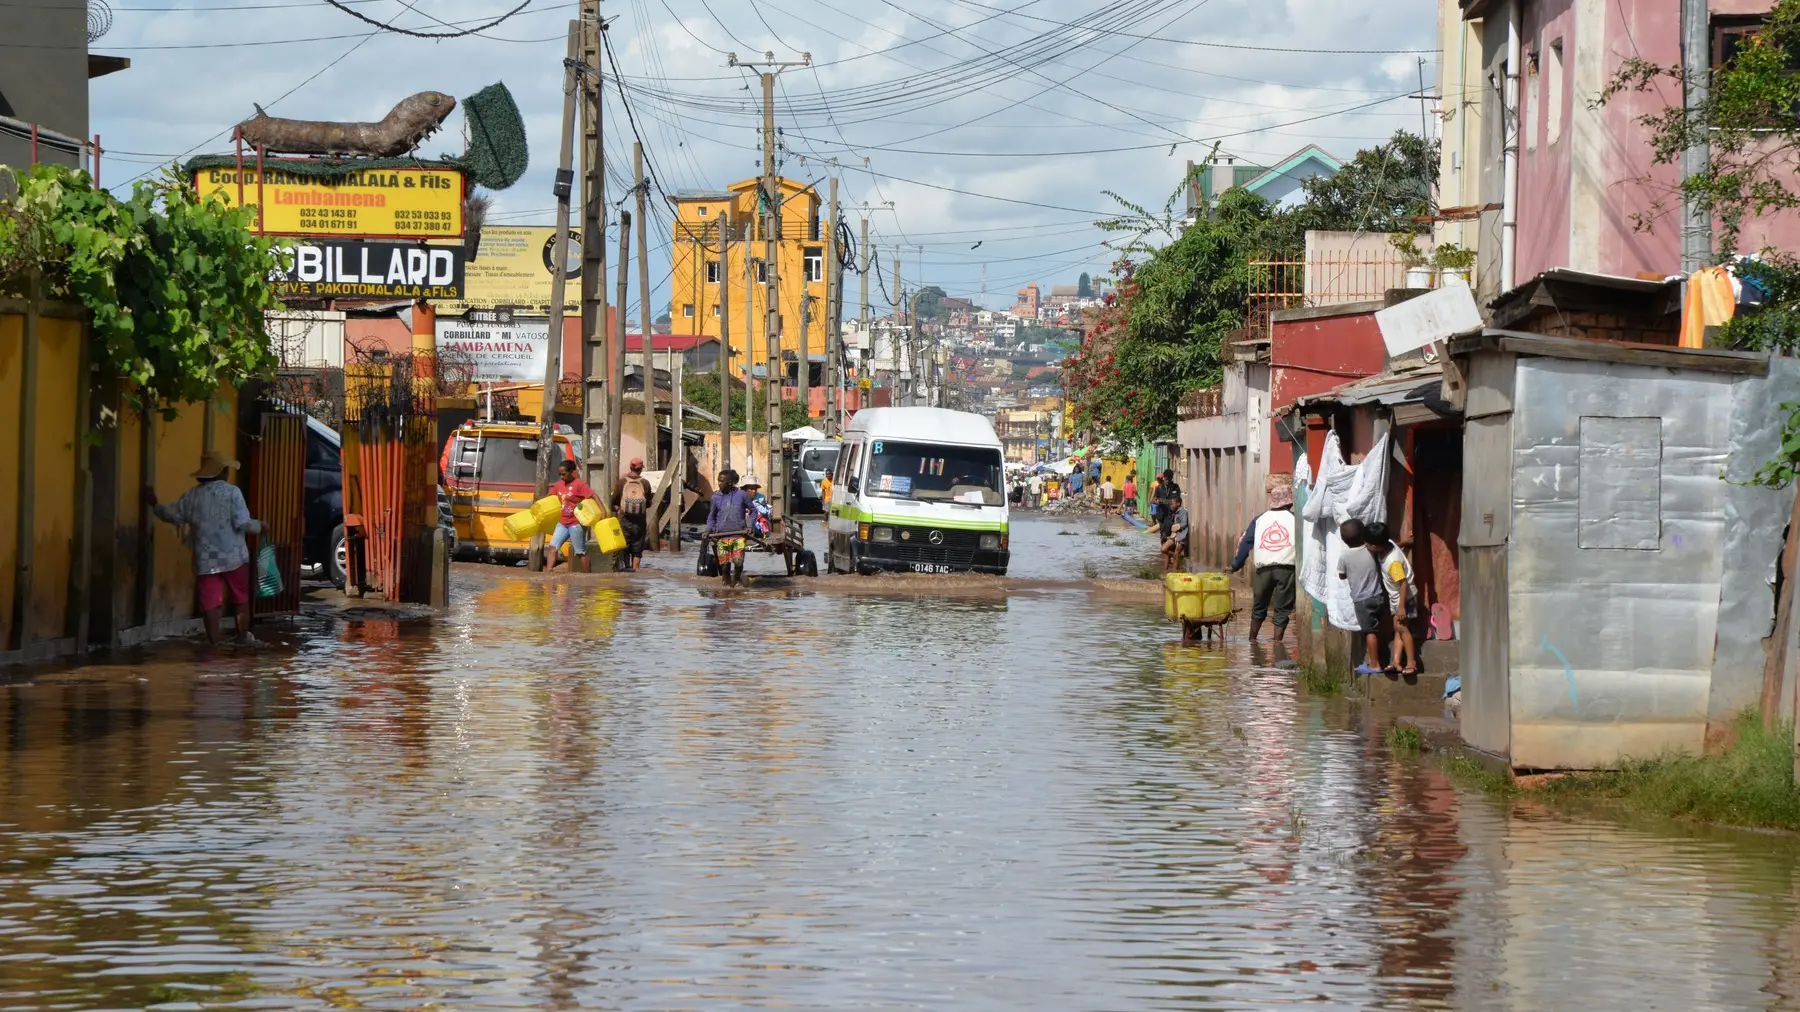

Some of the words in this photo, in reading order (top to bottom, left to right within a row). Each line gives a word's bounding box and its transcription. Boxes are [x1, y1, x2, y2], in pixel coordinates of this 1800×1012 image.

[403, 176, 416, 188] &
[420, 175, 451, 189] Fils
[274, 188, 386, 207] Lambamena
[300, 208, 316, 216] 032
[318, 209, 329, 217] 43
[331, 209, 345, 217] 143
[395, 210, 410, 219] 032
[412, 211, 422, 219] 53
[424, 211, 439, 219] 033
[441, 212, 451, 220] 93
[300, 219, 317, 228] 034
[319, 220, 329, 228] 01
[331, 220, 345, 228] 671
[347, 220, 357, 229] 91
[395, 221, 410, 229] 034
[413, 222, 422, 230] 37
[424, 222, 440, 230] 380
[442, 222, 451, 231] 47
[316, 282, 420, 297] RAKOTOMALALA
[432, 286, 457, 298] FILS
[469, 310, 497, 321] ENTRÉE
[443, 330, 491, 339] CORBILLARD
[445, 342, 533, 352] LAMBAMENA
[873, 441, 883, 454] B
